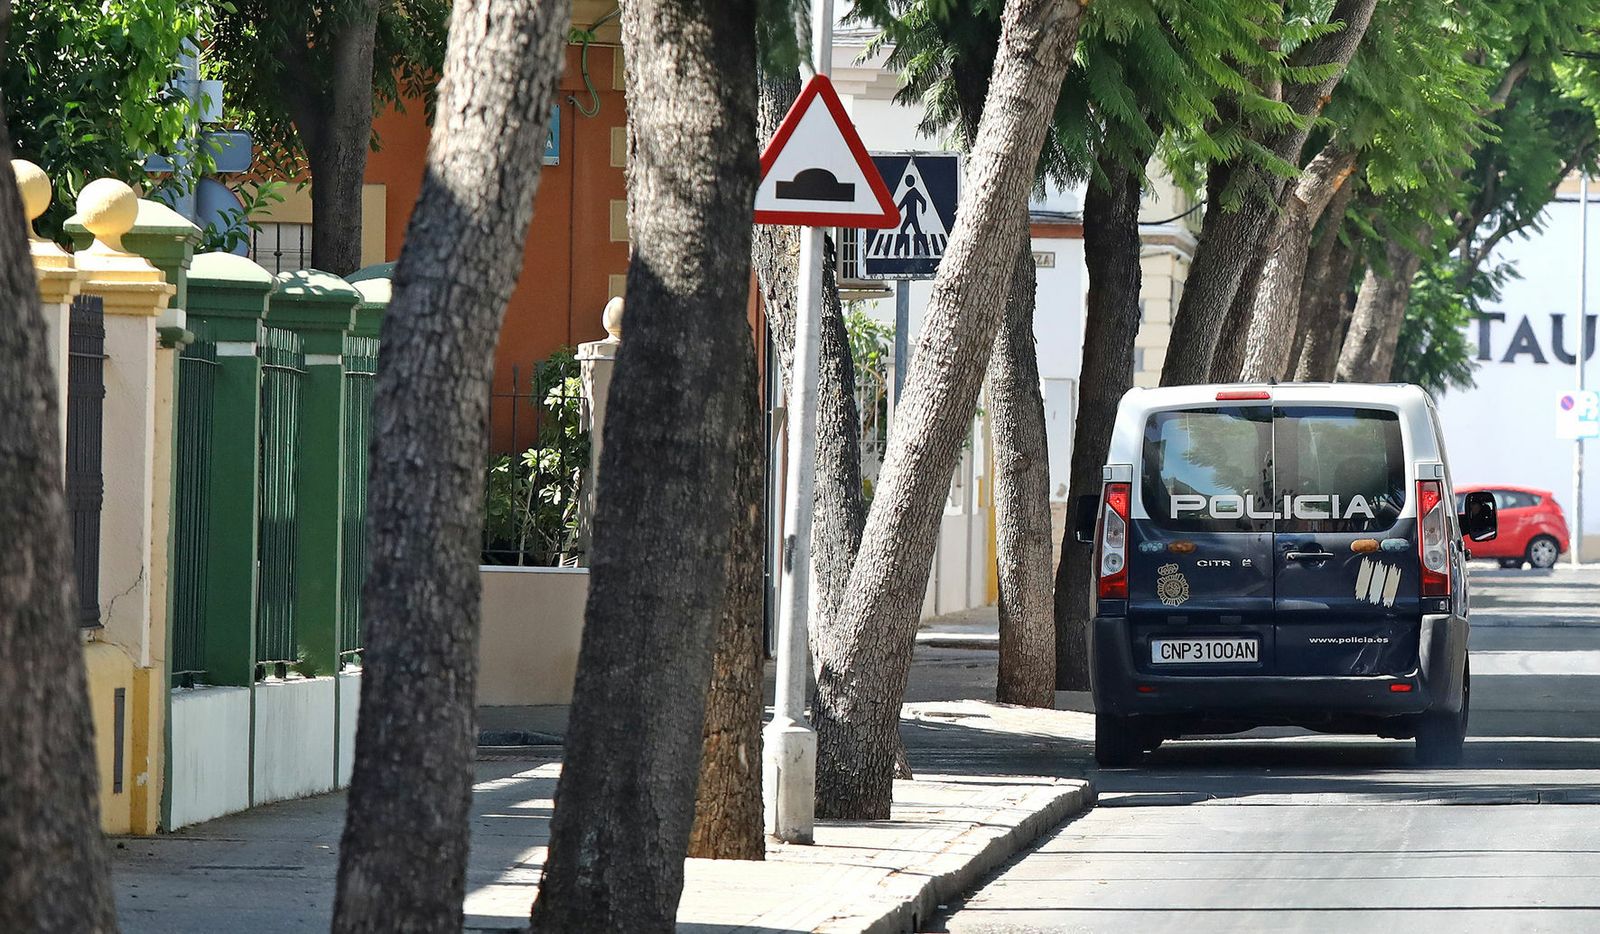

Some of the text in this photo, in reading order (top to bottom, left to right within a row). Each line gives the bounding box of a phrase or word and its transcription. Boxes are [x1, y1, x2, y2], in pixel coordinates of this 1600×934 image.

[1170, 495, 1375, 520] POLICIA
[1309, 636, 1389, 645] www.policia.es
[1161, 642, 1256, 660] CNP3100AN
